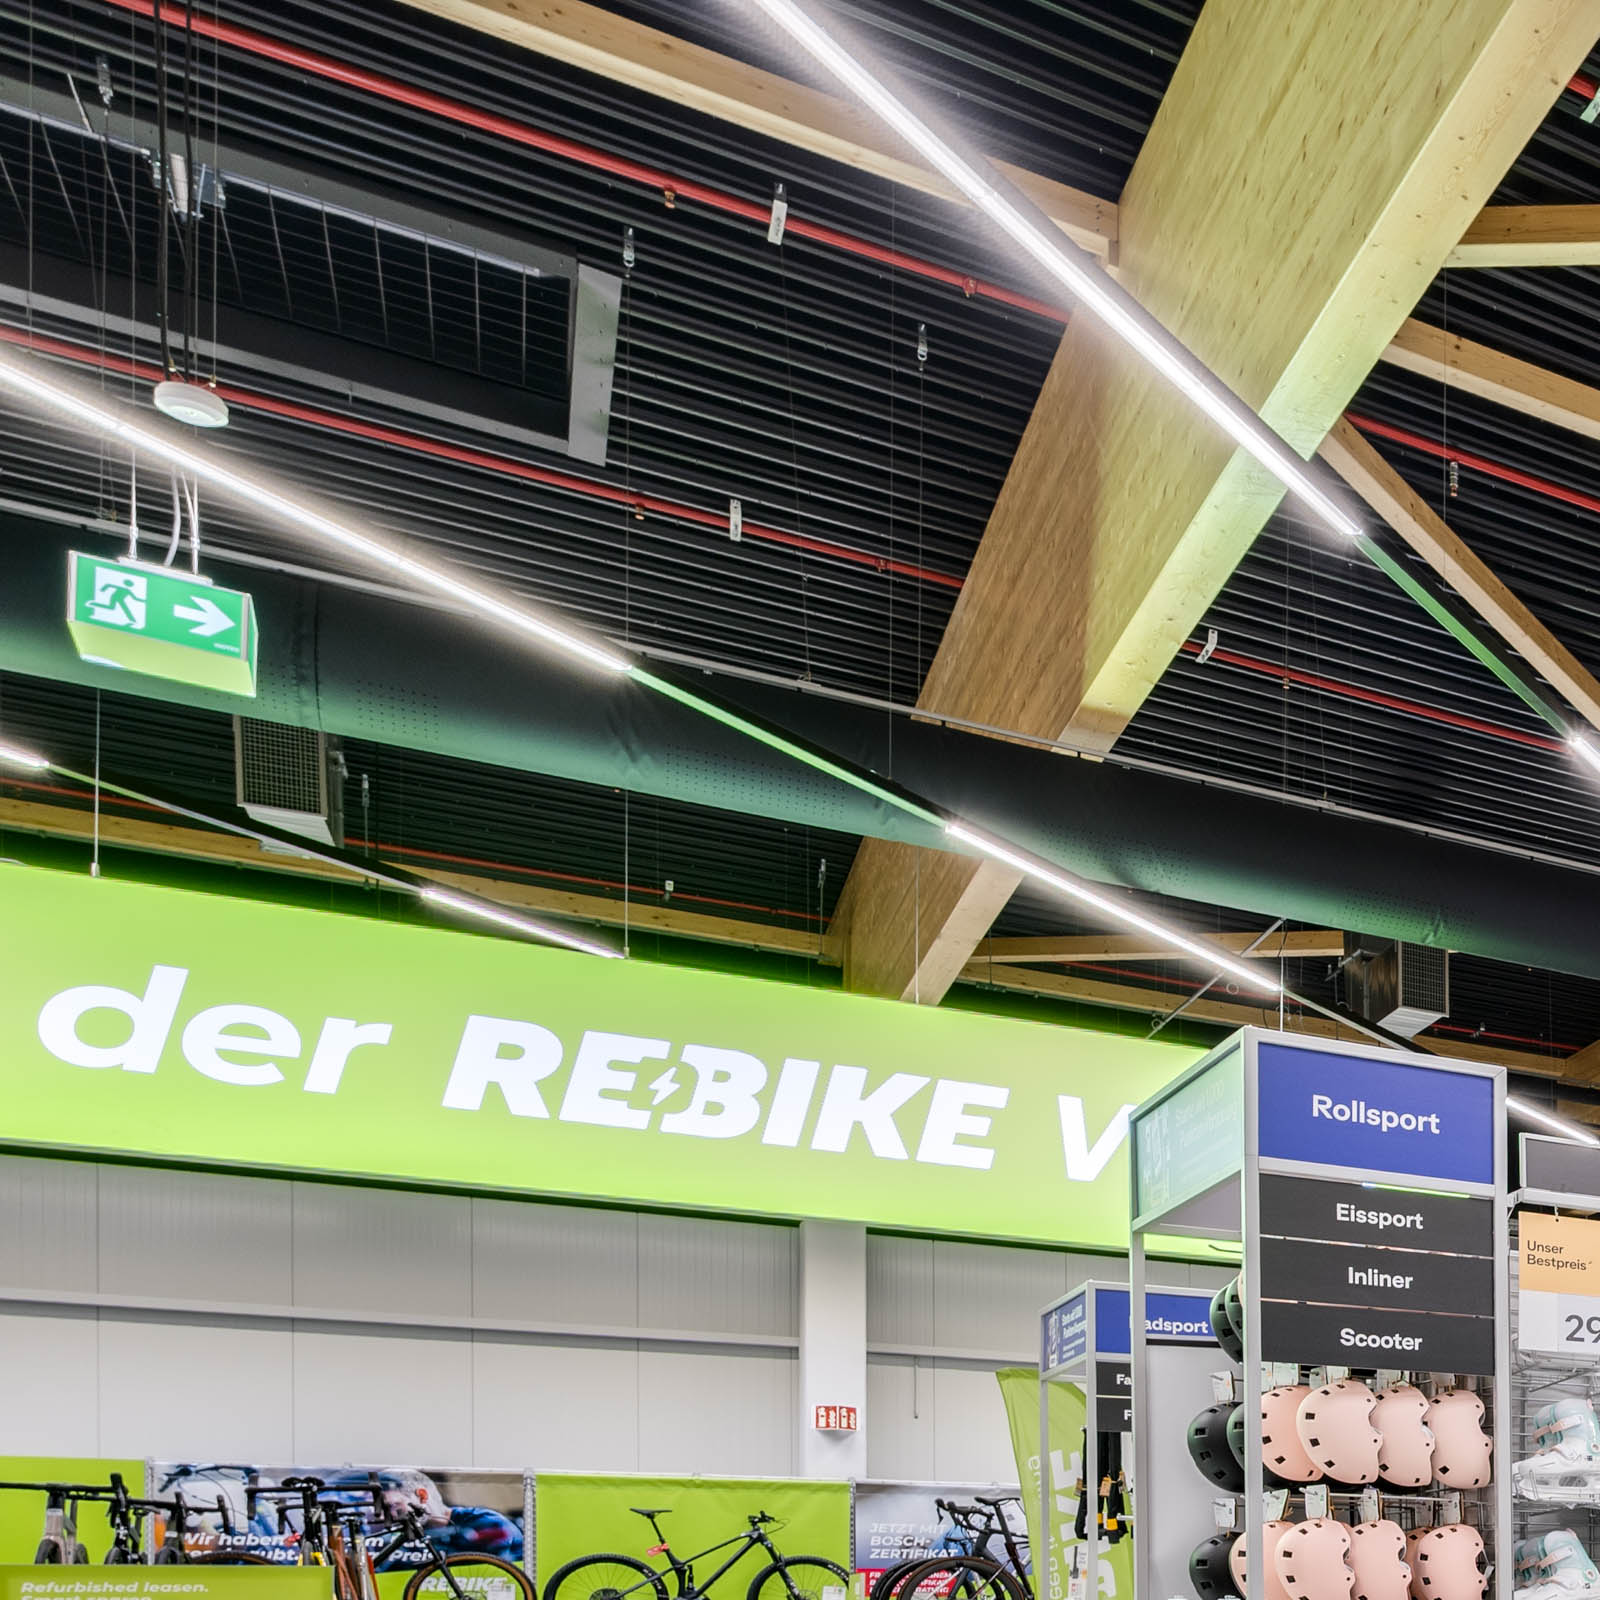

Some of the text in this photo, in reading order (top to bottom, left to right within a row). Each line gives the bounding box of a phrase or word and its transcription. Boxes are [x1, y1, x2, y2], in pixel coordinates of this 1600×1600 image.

[37, 964, 392, 1097] der
[443, 1013, 1011, 1170] REBIKE
[1312, 1094, 1440, 1135] Rollsport
[1336, 1203, 1424, 1230] Eissport
[1527, 1240, 1564, 1255] Unser
[1527, 1254, 1587, 1272] Bestpreis
[1348, 1266, 1413, 1290] Inliner
[1129, 1314, 1208, 1335] adsport
[1339, 1327, 1423, 1351] Scooter
[869, 1523, 948, 1534] JETZT MIT
[870, 1536, 932, 1546] BOSCH-
[869, 1549, 959, 1560] ZERTIFIKAT
[20, 1581, 209, 1594] Refurbished leasen.
